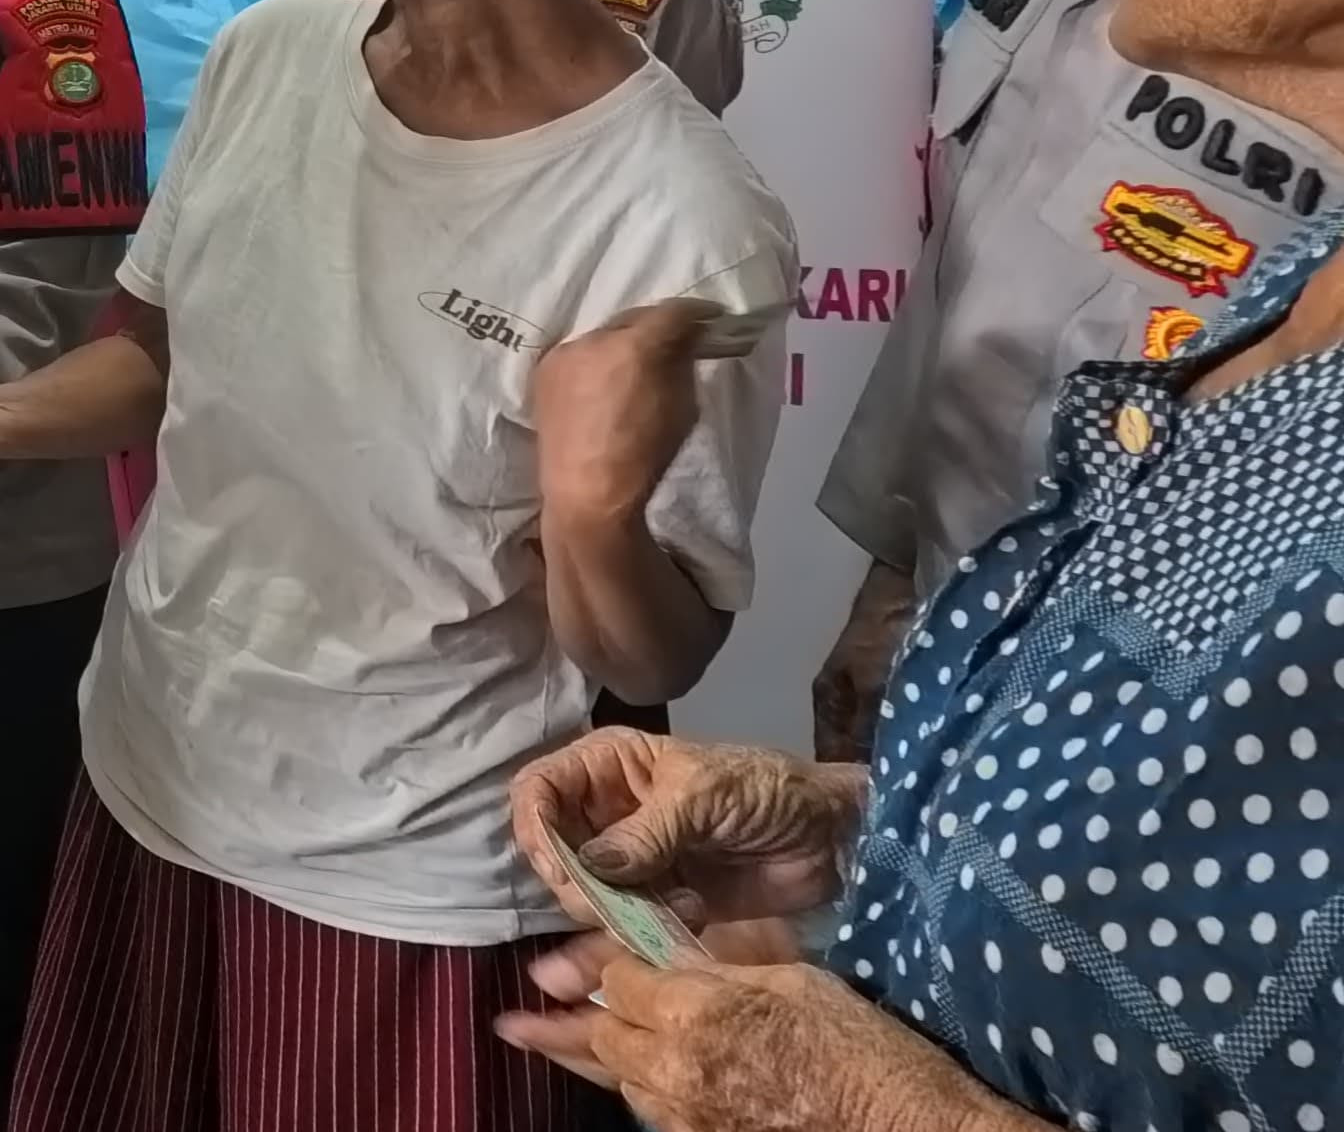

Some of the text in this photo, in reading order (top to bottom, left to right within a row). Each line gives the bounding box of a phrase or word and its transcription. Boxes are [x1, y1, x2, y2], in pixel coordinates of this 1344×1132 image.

[36, 23, 96, 39] METRO JAYA
[1125, 74, 1323, 216] POLRI
[440, 288, 526, 353] Light
